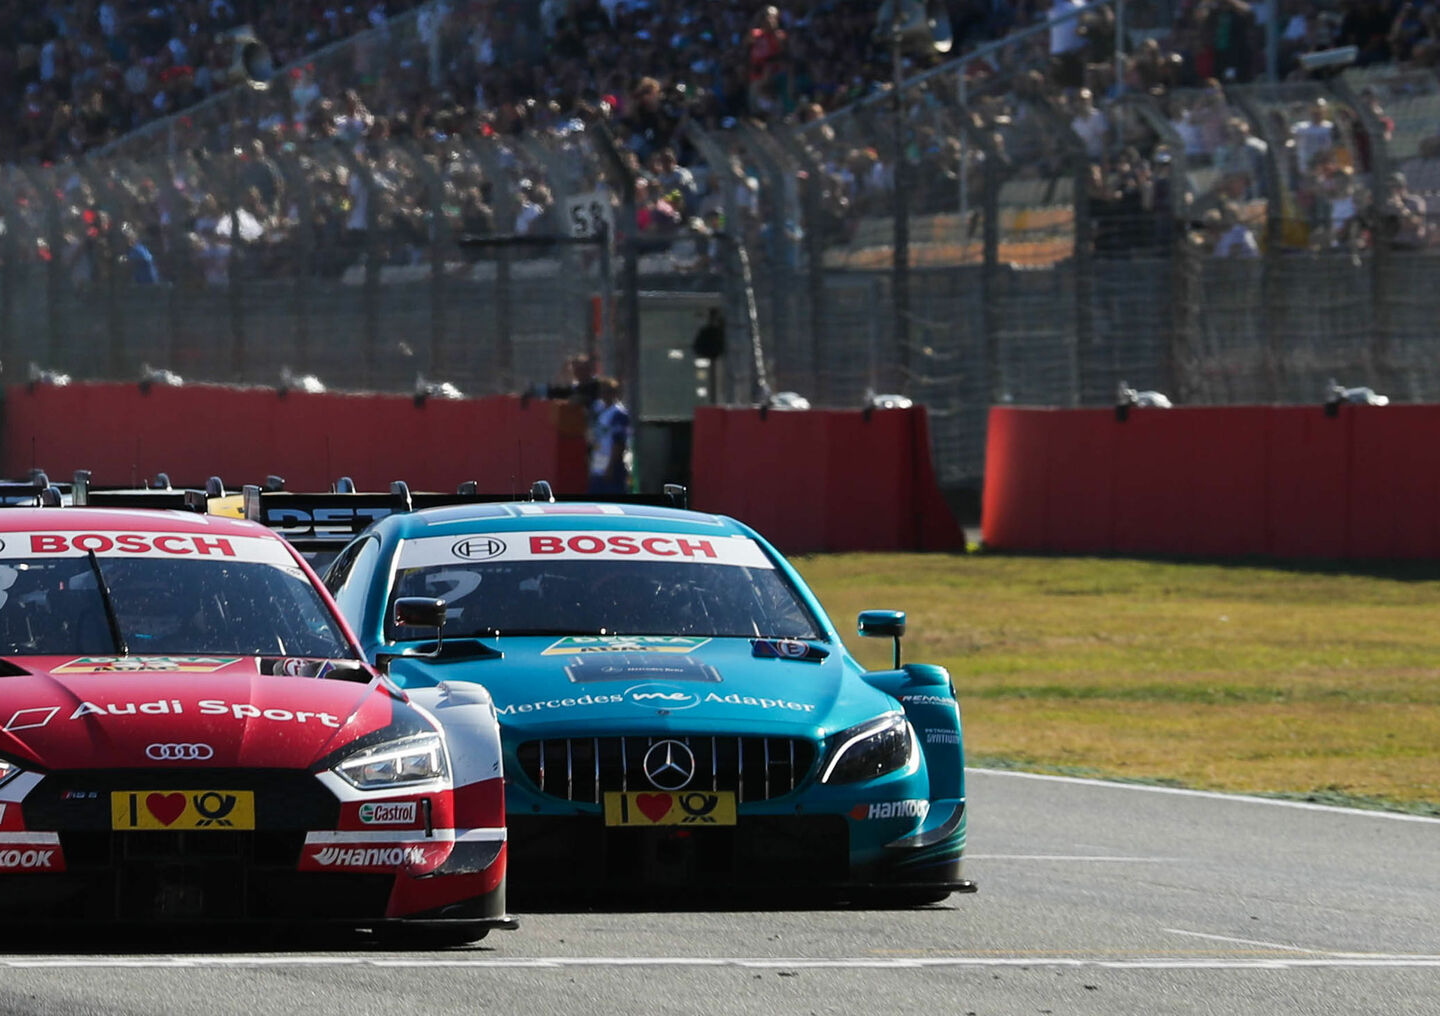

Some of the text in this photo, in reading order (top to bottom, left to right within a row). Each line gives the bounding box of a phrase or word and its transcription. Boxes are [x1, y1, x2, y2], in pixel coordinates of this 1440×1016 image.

[30, 534, 236, 557] BOSCH
[529, 535, 718, 558] BOSCH
[70, 700, 341, 728] Audi Sport
[496, 691, 816, 716] Mercedes me Adapter
[129, 793, 138, 827] I
[373, 804, 415, 822] Castrol
[620, 794, 629, 823] I
